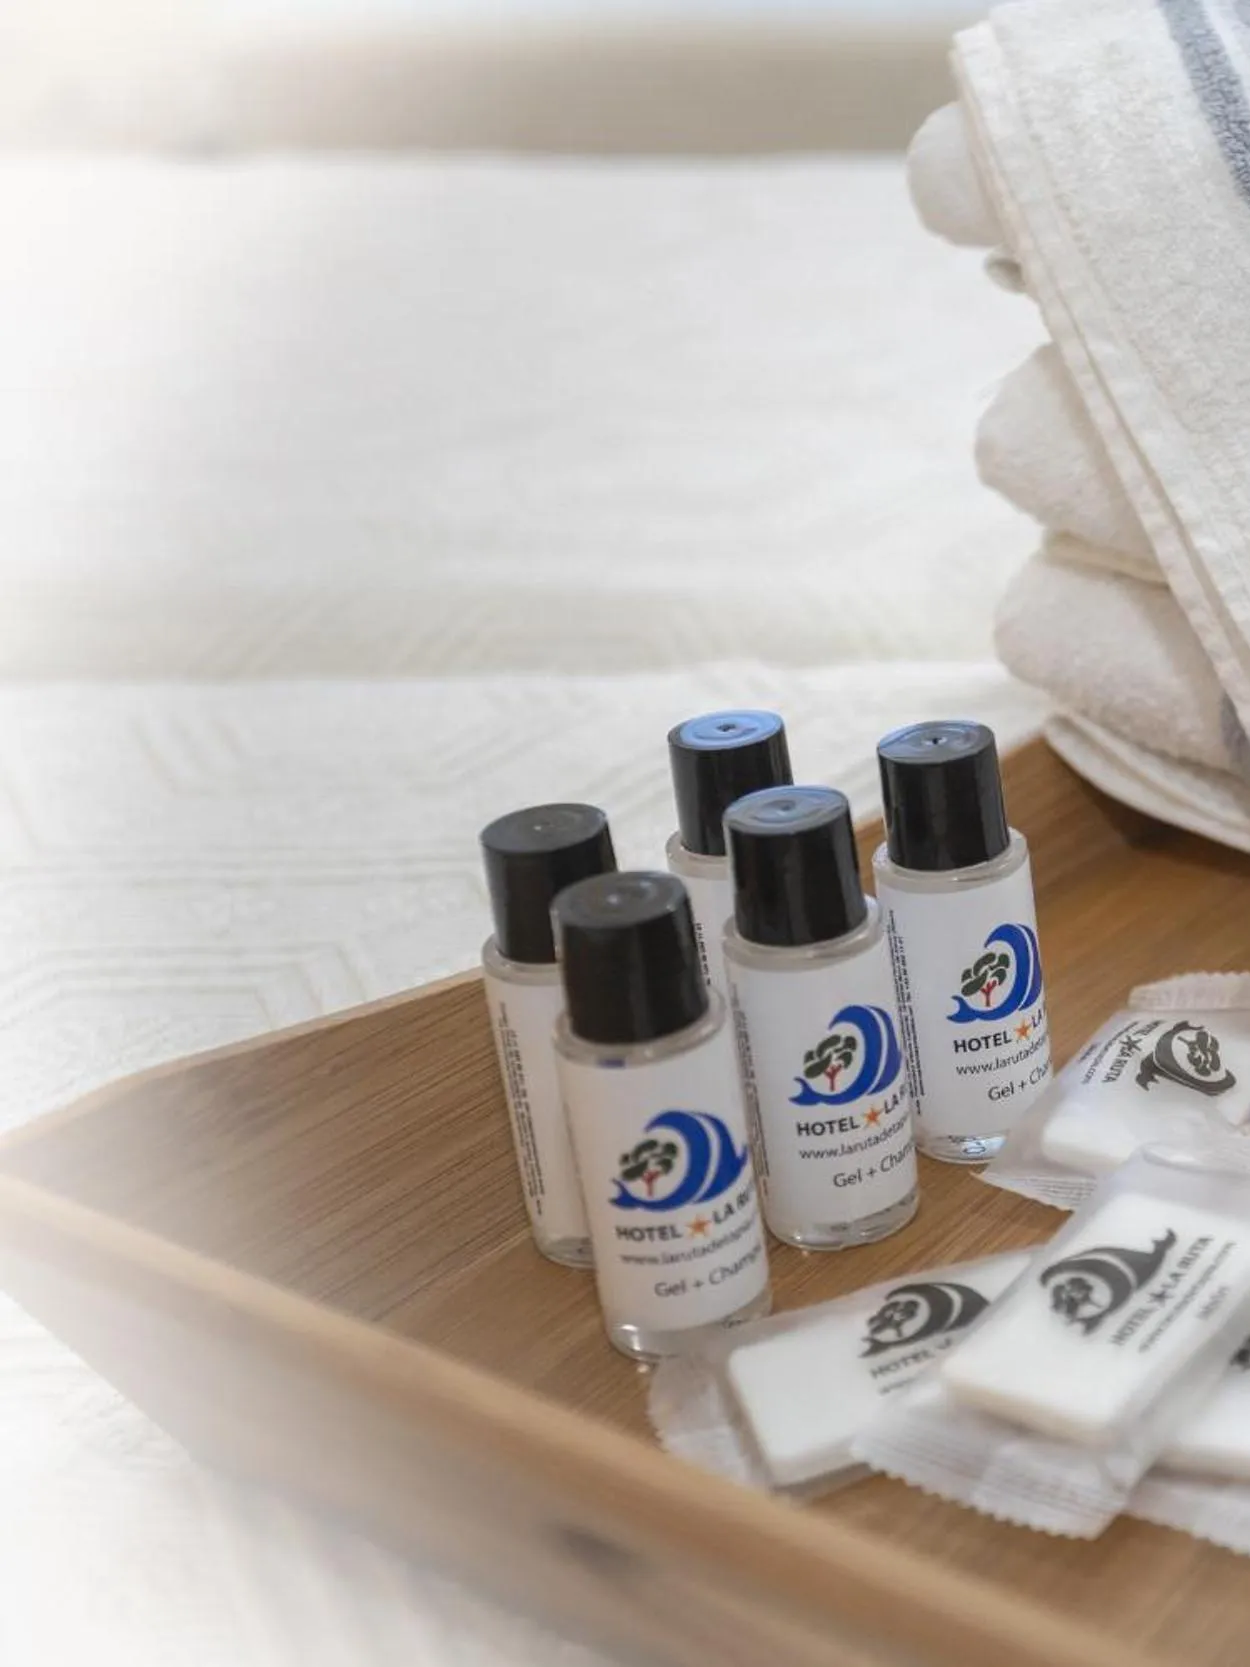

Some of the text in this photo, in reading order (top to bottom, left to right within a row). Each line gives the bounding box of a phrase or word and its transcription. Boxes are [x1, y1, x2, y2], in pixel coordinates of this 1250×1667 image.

[953, 1030, 1012, 1054] HOTEL
[987, 1081, 1015, 1101] Gel
[796, 1116, 860, 1137] HOTEL
[883, 1093, 901, 1115] LA
[833, 1167, 863, 1188] Gel
[615, 1224, 683, 1242] HOTEL
[712, 1202, 735, 1224] LA
[654, 1279, 687, 1298] Gel
[869, 1350, 936, 1380] HOTEL
